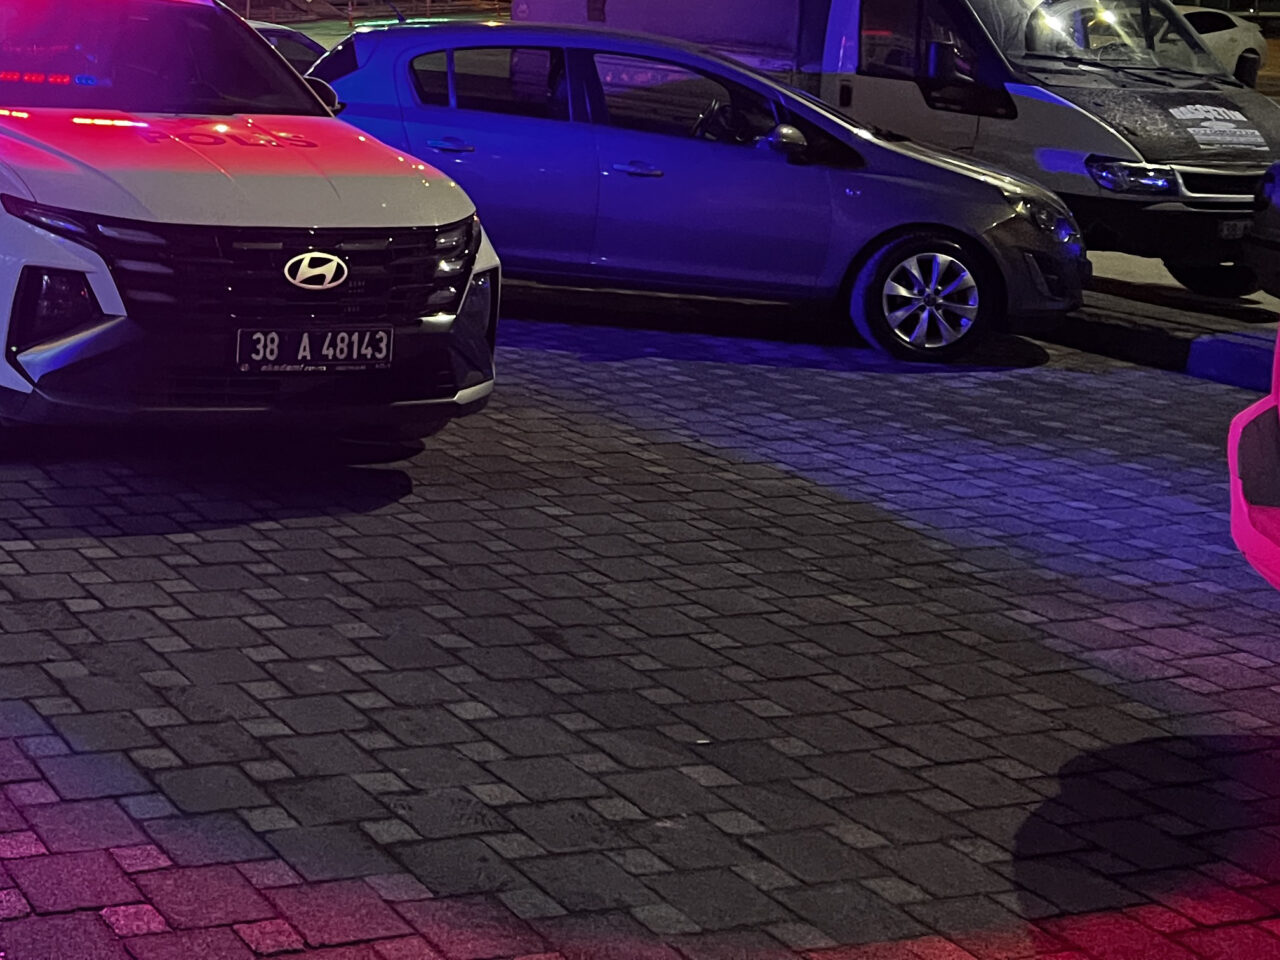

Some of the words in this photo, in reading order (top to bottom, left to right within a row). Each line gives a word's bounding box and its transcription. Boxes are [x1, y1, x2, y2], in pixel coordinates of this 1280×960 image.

[251, 332, 279, 361] 38
[298, 332, 311, 360] A
[322, 330, 388, 360] 48143
